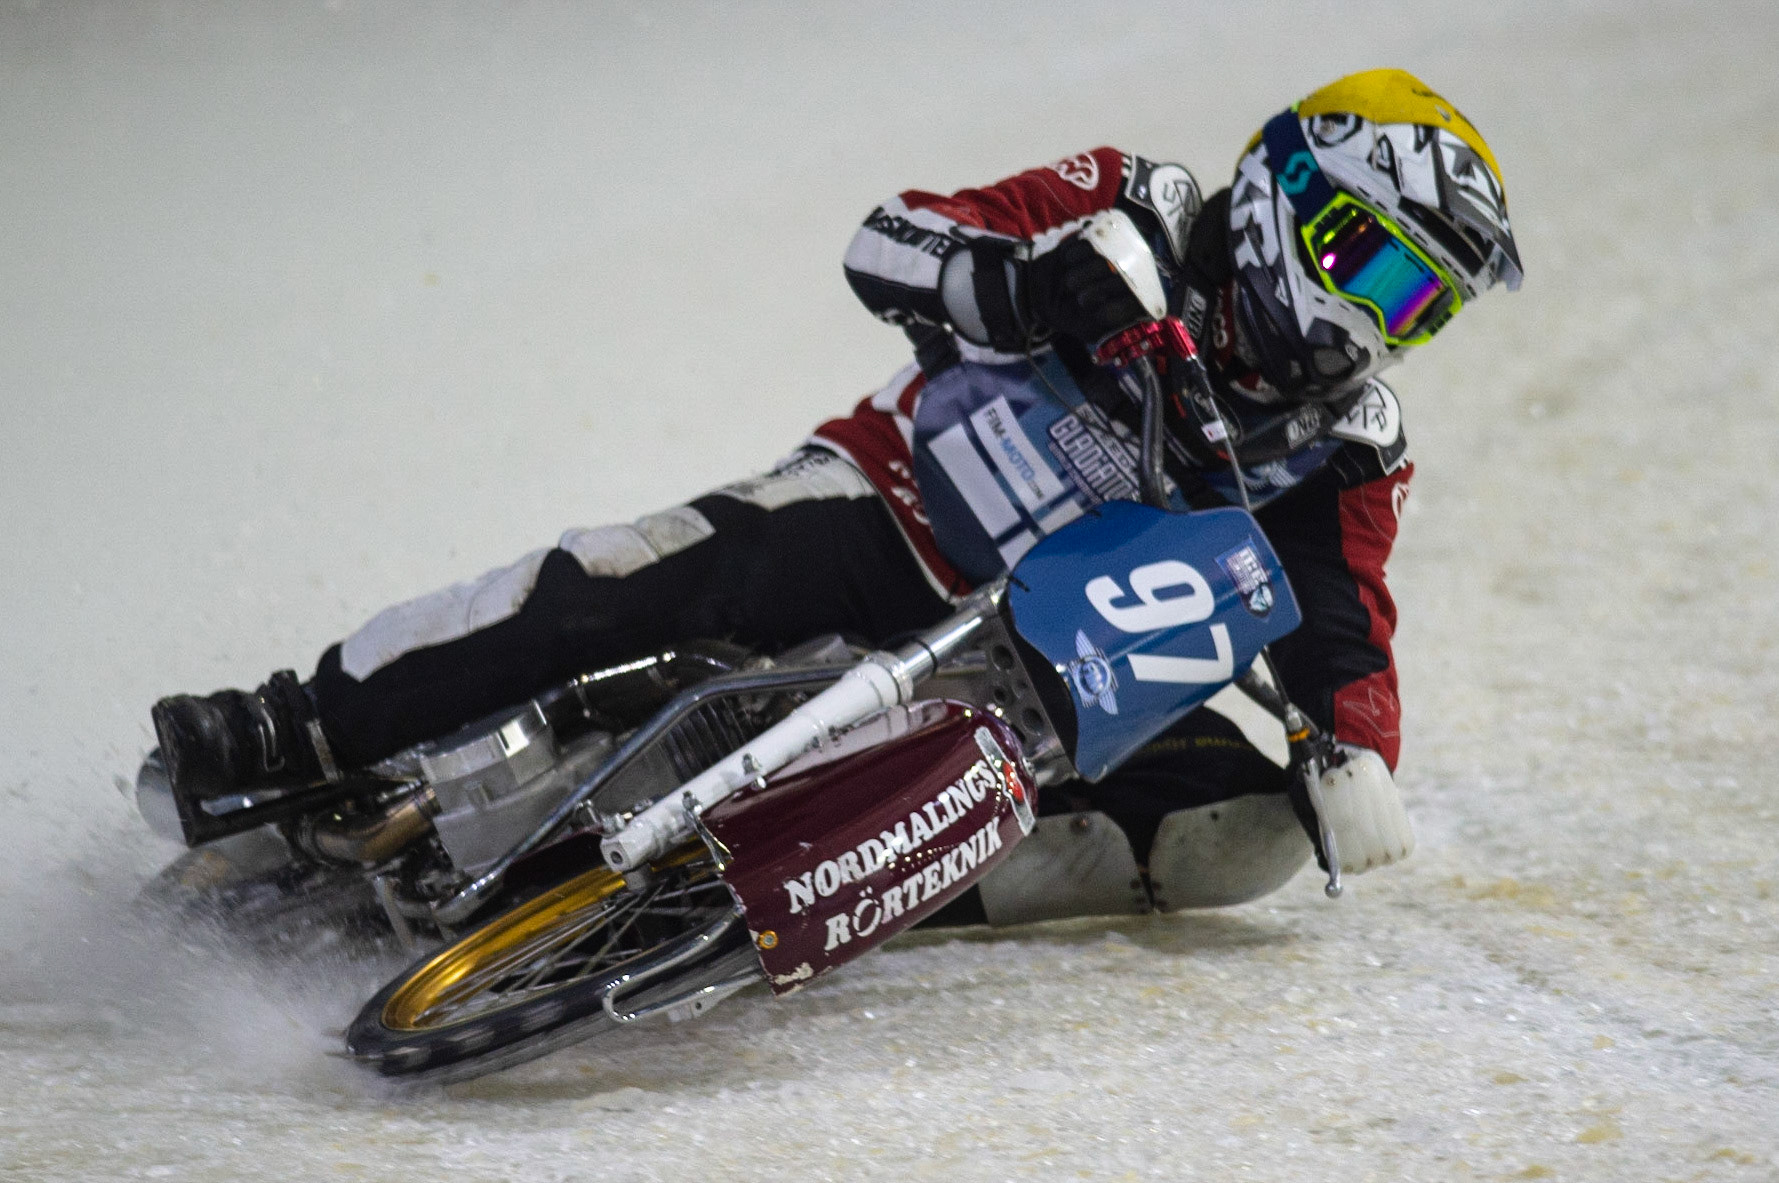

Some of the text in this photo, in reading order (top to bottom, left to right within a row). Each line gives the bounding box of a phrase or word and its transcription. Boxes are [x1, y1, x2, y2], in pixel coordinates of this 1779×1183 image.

[1085, 560, 1234, 684] 97
[784, 759, 997, 914] NORDMALINGS
[825, 816, 1002, 951] RÖRTEKNIK
